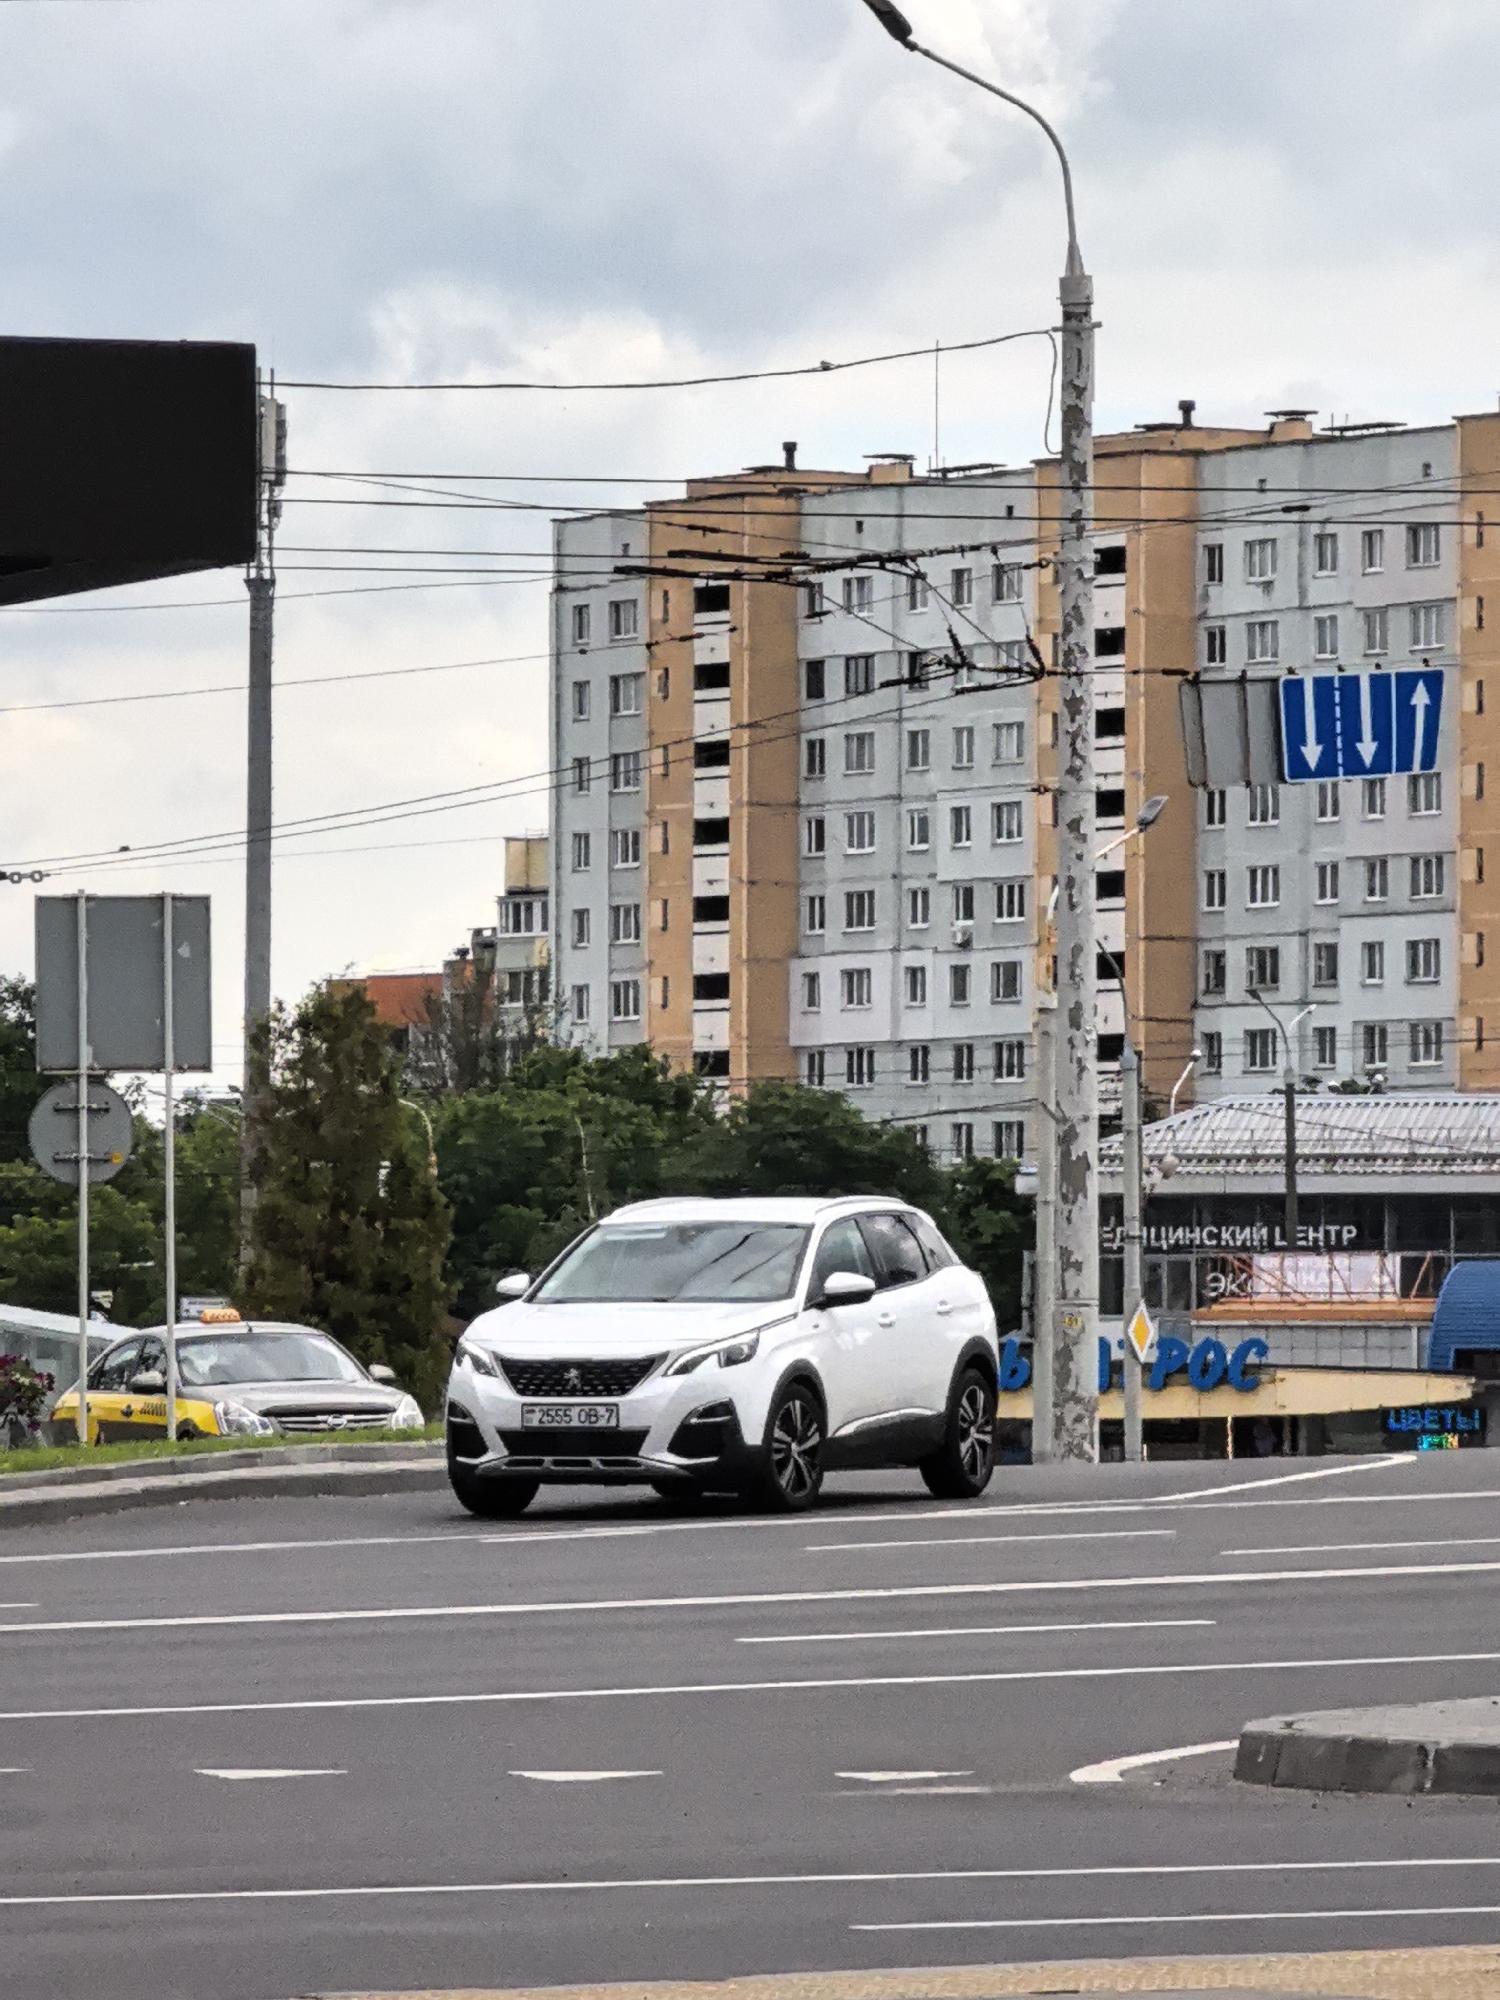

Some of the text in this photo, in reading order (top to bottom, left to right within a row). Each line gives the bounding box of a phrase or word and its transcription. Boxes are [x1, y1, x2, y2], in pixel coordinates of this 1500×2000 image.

[1102, 1222, 1268, 1250] ЕДЦИНСКИЙ
[538, 1407, 573, 1424] 2555
[1387, 1408, 1480, 1431] ЦВЕТЫ
